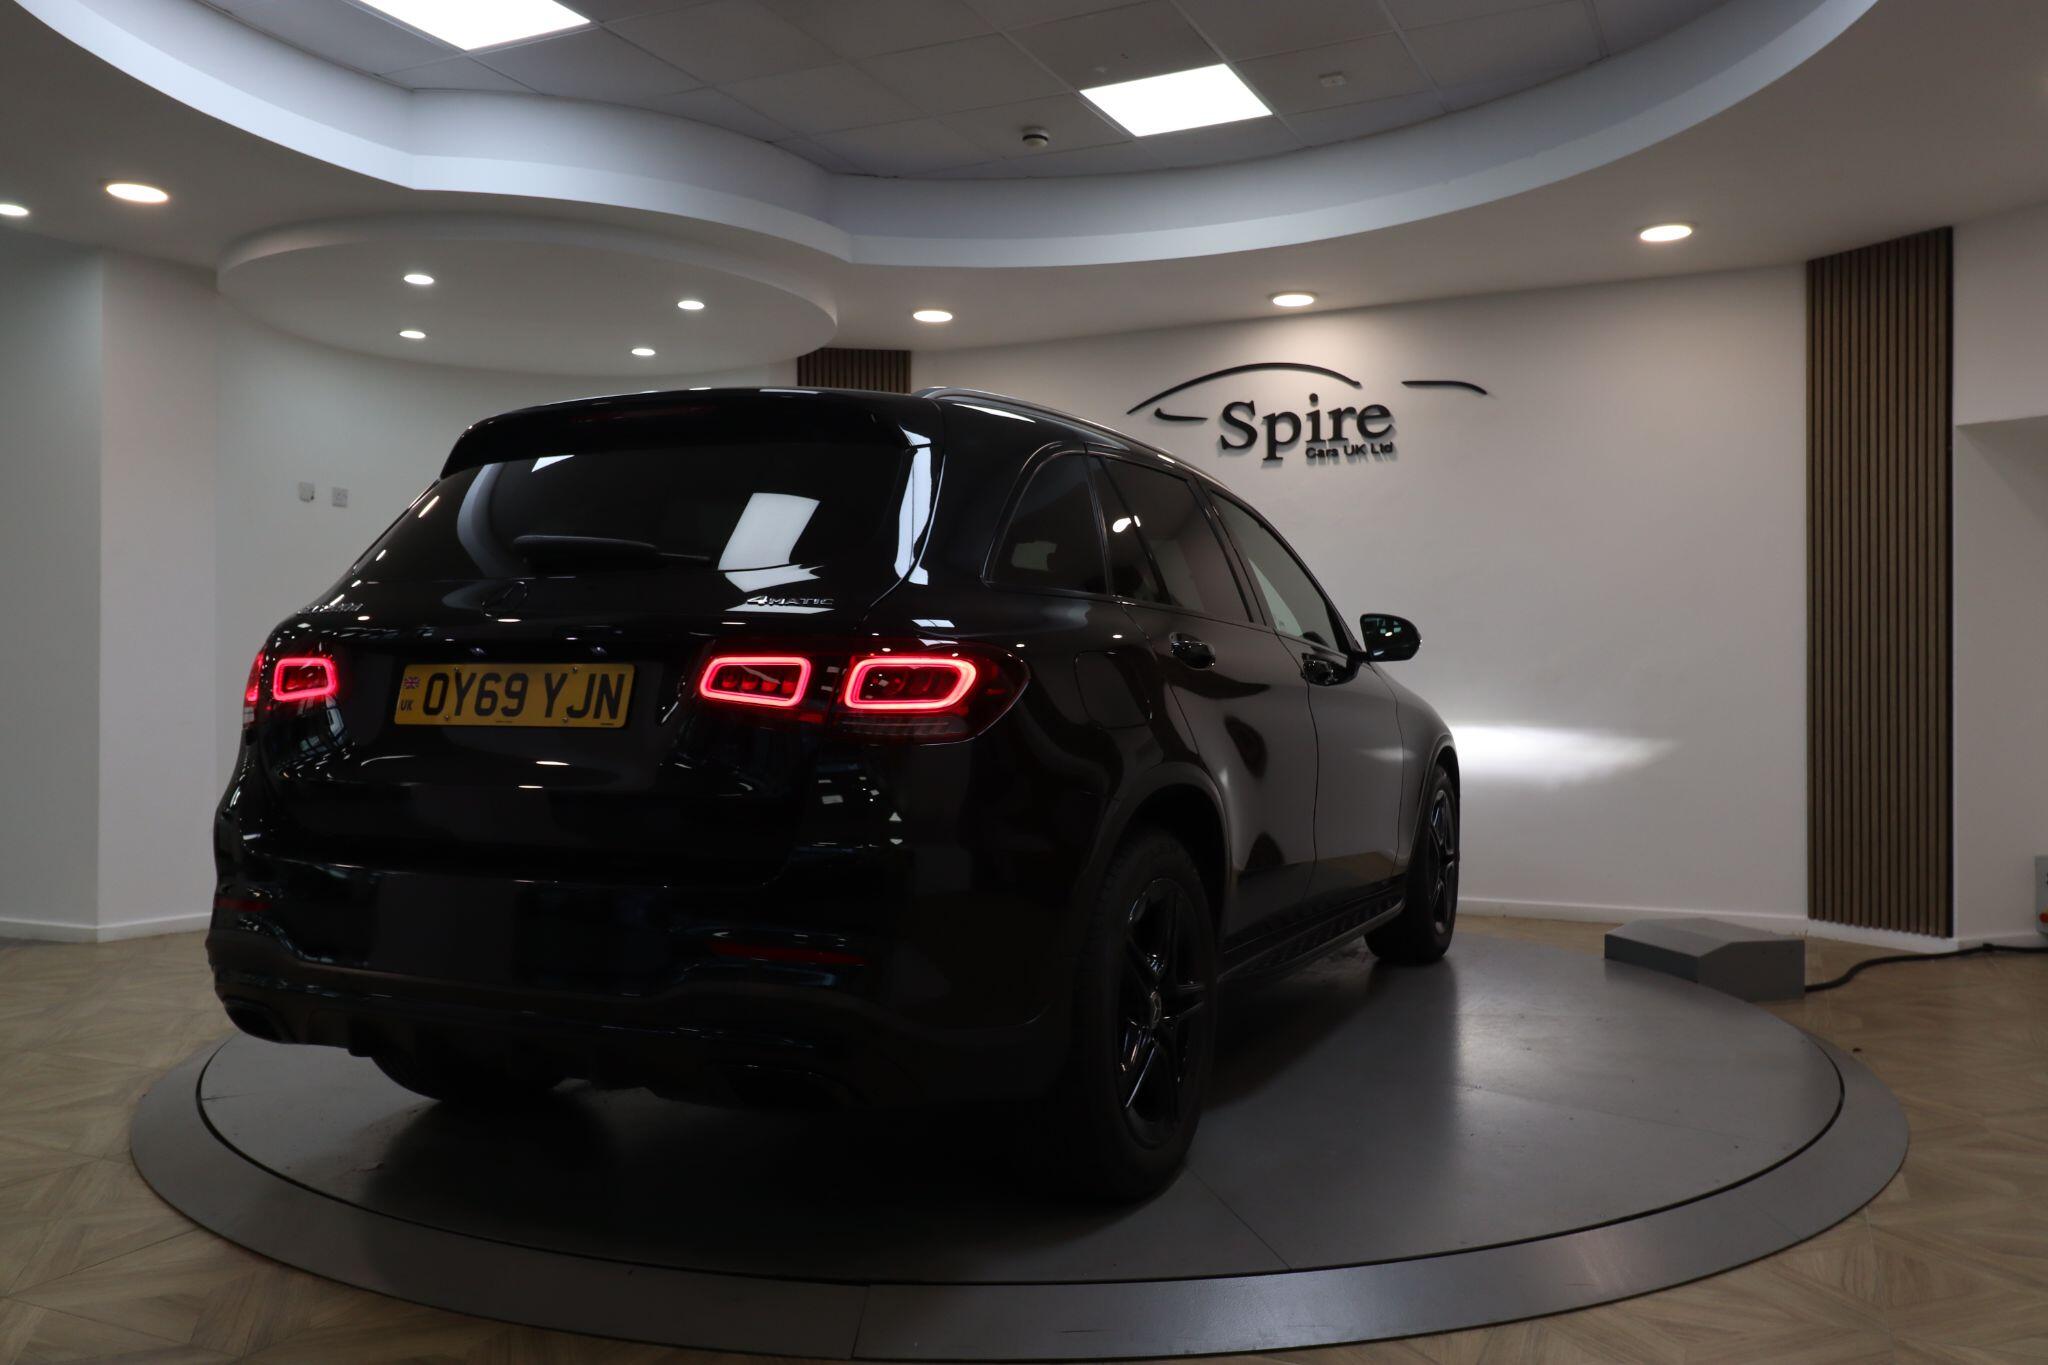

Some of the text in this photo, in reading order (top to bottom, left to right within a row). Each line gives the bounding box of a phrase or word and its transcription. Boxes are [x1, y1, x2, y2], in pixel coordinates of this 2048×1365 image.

[1220, 393, 1392, 460] Spire
[1306, 442, 1393, 459] Cars UK Ltd
[747, 595, 835, 605] 4MATIC
[423, 672, 625, 719] OY69 YJN
[400, 699, 415, 712] UK
